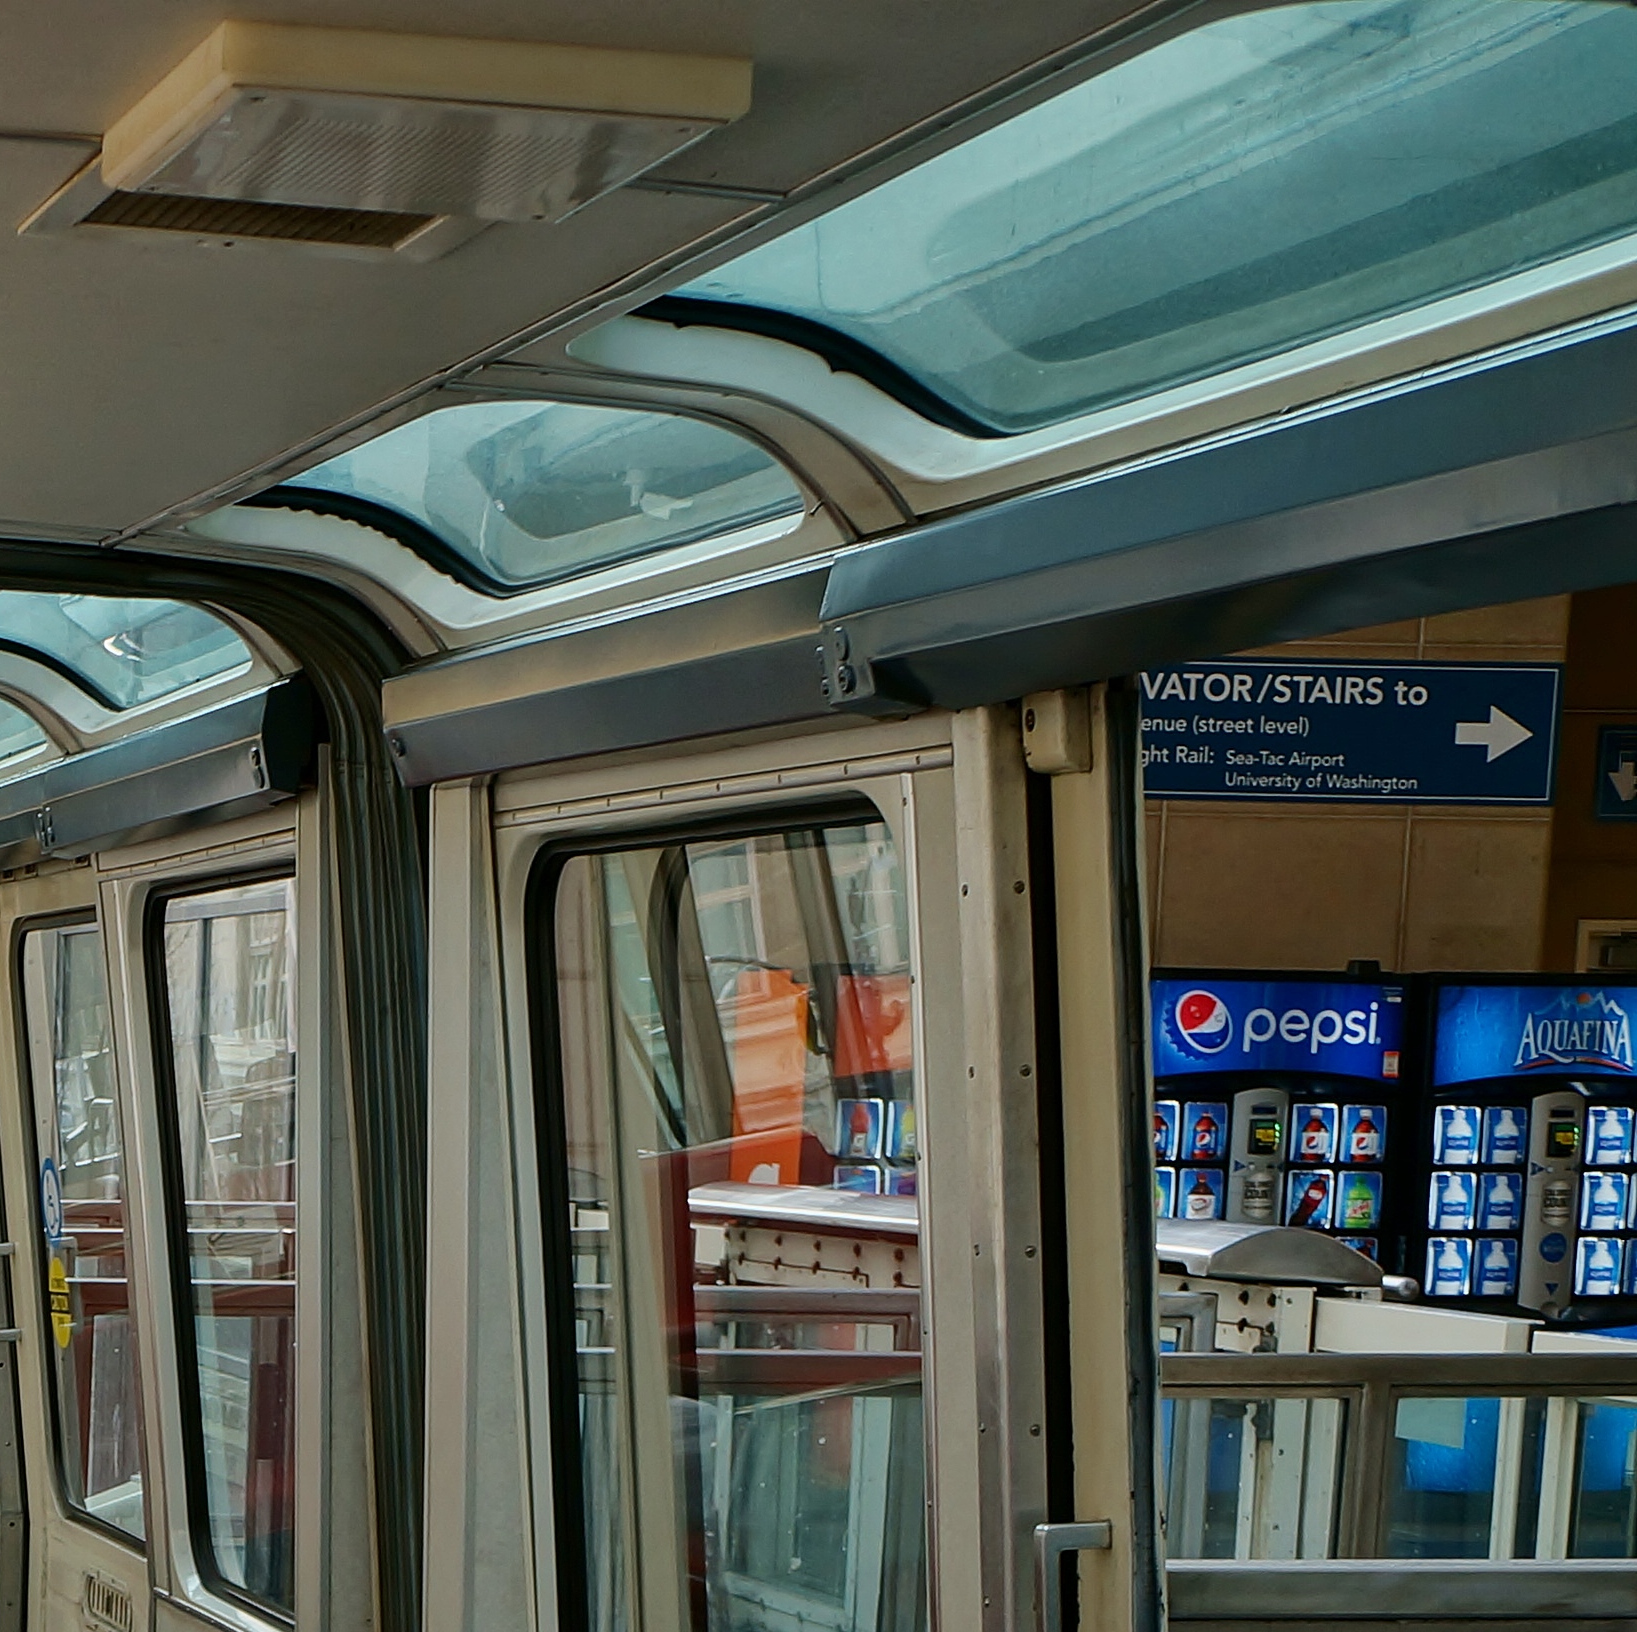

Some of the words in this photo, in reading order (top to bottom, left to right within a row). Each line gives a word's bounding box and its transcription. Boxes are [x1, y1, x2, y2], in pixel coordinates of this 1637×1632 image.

[1393, 680, 1428, 706] to
[1141, 717, 1188, 732] enue
[1192, 714, 1255, 736] (street
[1260, 715, 1310, 737] level)
[1175, 745, 1216, 765] Rail:
[1225, 749, 1286, 767] Sea-Tac
[1288, 751, 1345, 771] Airport
[1225, 771, 1302, 791] University
[1305, 772, 1323, 788] of
[1326, 773, 1418, 793] Washington
[1242, 1001, 1380, 1054] pepsi
[1513, 1011, 1633, 1068] AQUAFINA
